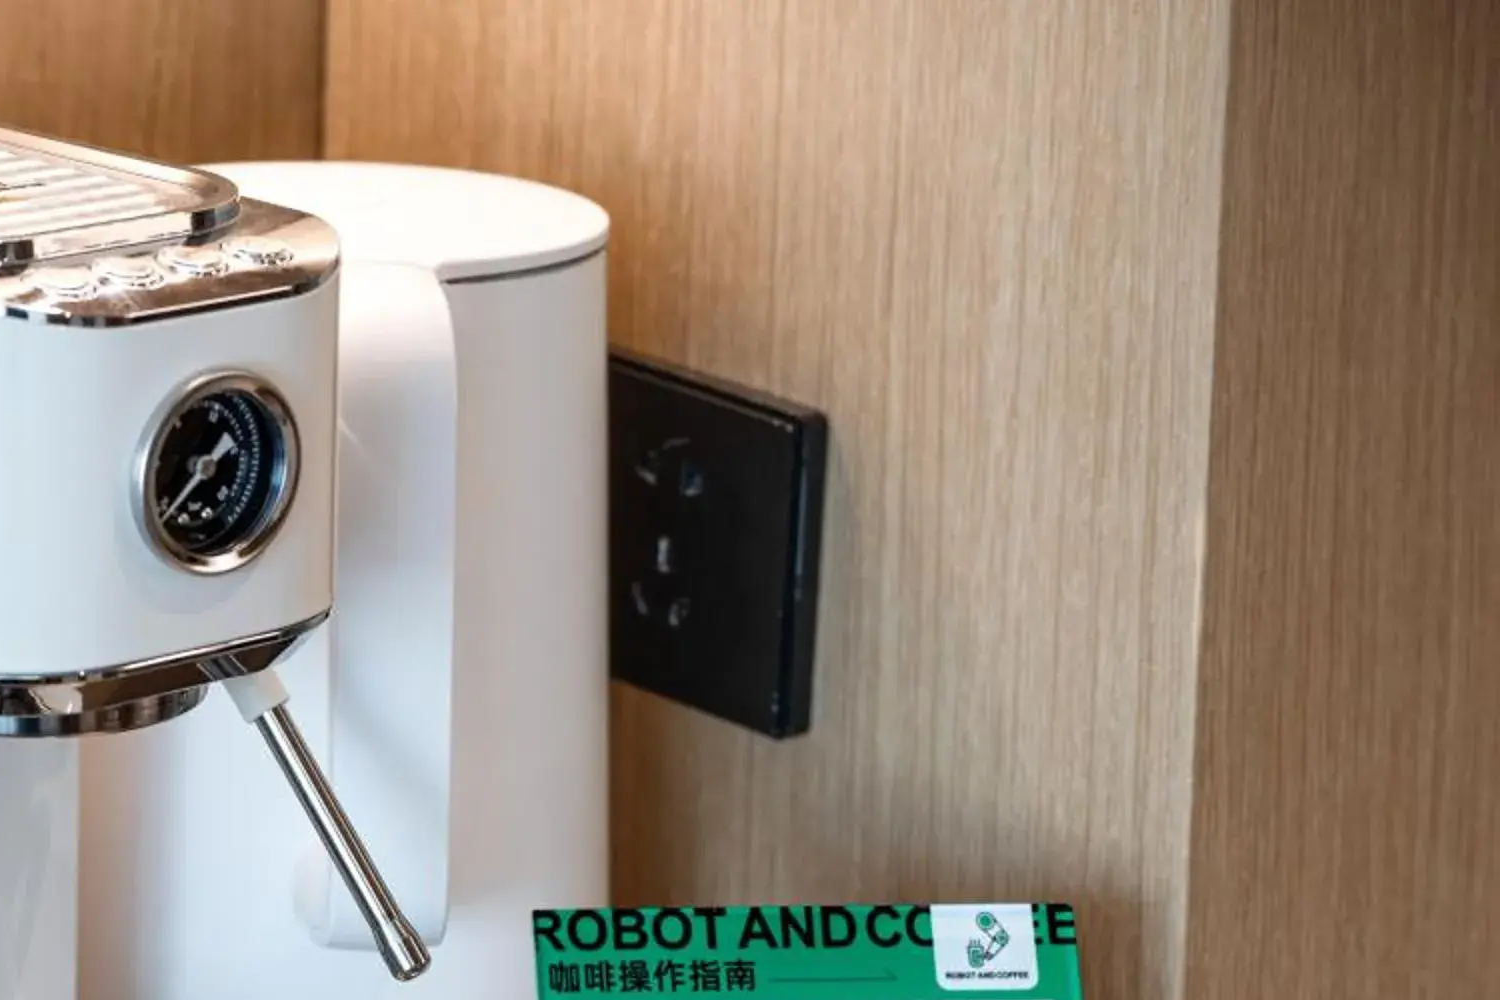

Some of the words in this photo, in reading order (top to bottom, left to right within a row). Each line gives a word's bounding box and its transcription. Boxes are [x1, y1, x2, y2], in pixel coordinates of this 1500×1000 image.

[532, 907, 727, 951] ROBOT
[739, 906, 857, 949] AND
[548, 959, 756, 993] 咖啡操作指南
